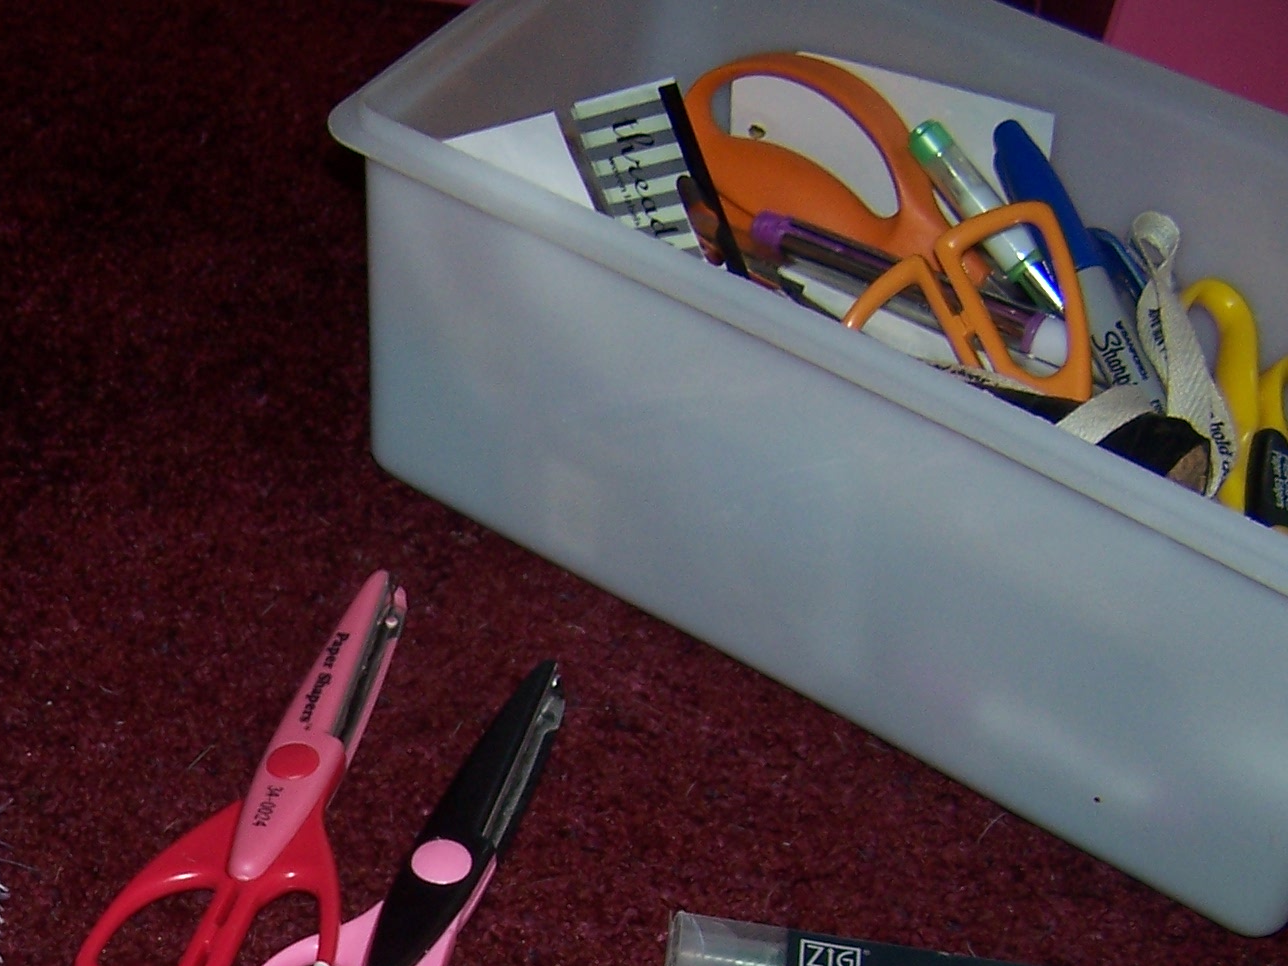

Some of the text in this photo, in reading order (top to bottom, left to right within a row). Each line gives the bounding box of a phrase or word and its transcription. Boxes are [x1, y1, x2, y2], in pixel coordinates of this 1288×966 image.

[612, 118, 679, 235] thread
[299, 632, 351, 724] Paper Shapers
[252, 785, 284, 828] 34-0024
